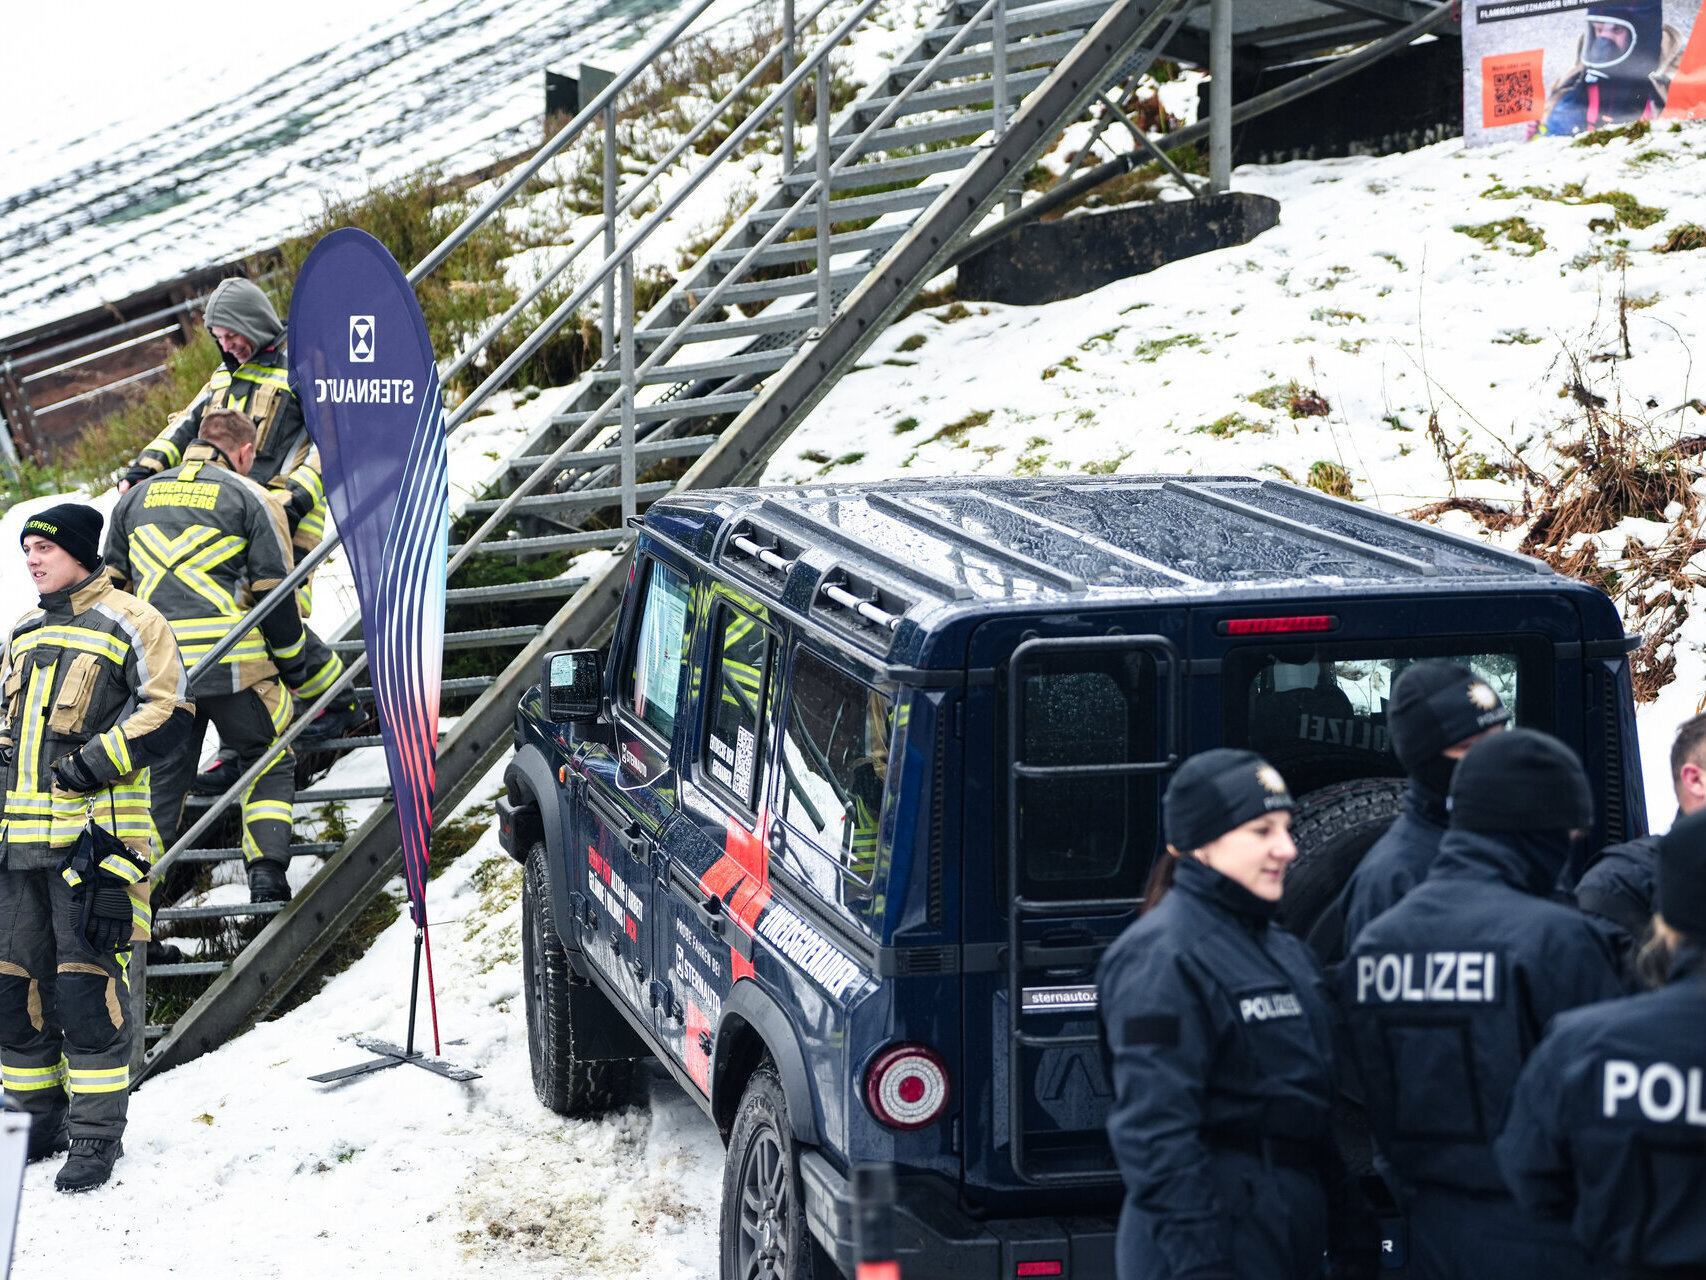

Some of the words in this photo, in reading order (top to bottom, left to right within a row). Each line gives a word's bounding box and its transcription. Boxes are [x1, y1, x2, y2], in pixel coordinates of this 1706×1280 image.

[1480, 2, 1562, 18] FLAMMSCHUTZHAUBEN
[143, 493, 217, 510] SONNEBERG
[147, 481, 220, 498] FEUERWEHR
[25, 520, 58, 535] UERWEHR
[676, 917, 692, 946] PROBE
[692, 935, 711, 968] FAHREN
[711, 957, 721, 978] BEI
[757, 903, 860, 999] #INEOSGRENADIER
[684, 958, 721, 1017] STERNAUTO
[1357, 952, 1496, 1003] POLIZEI
